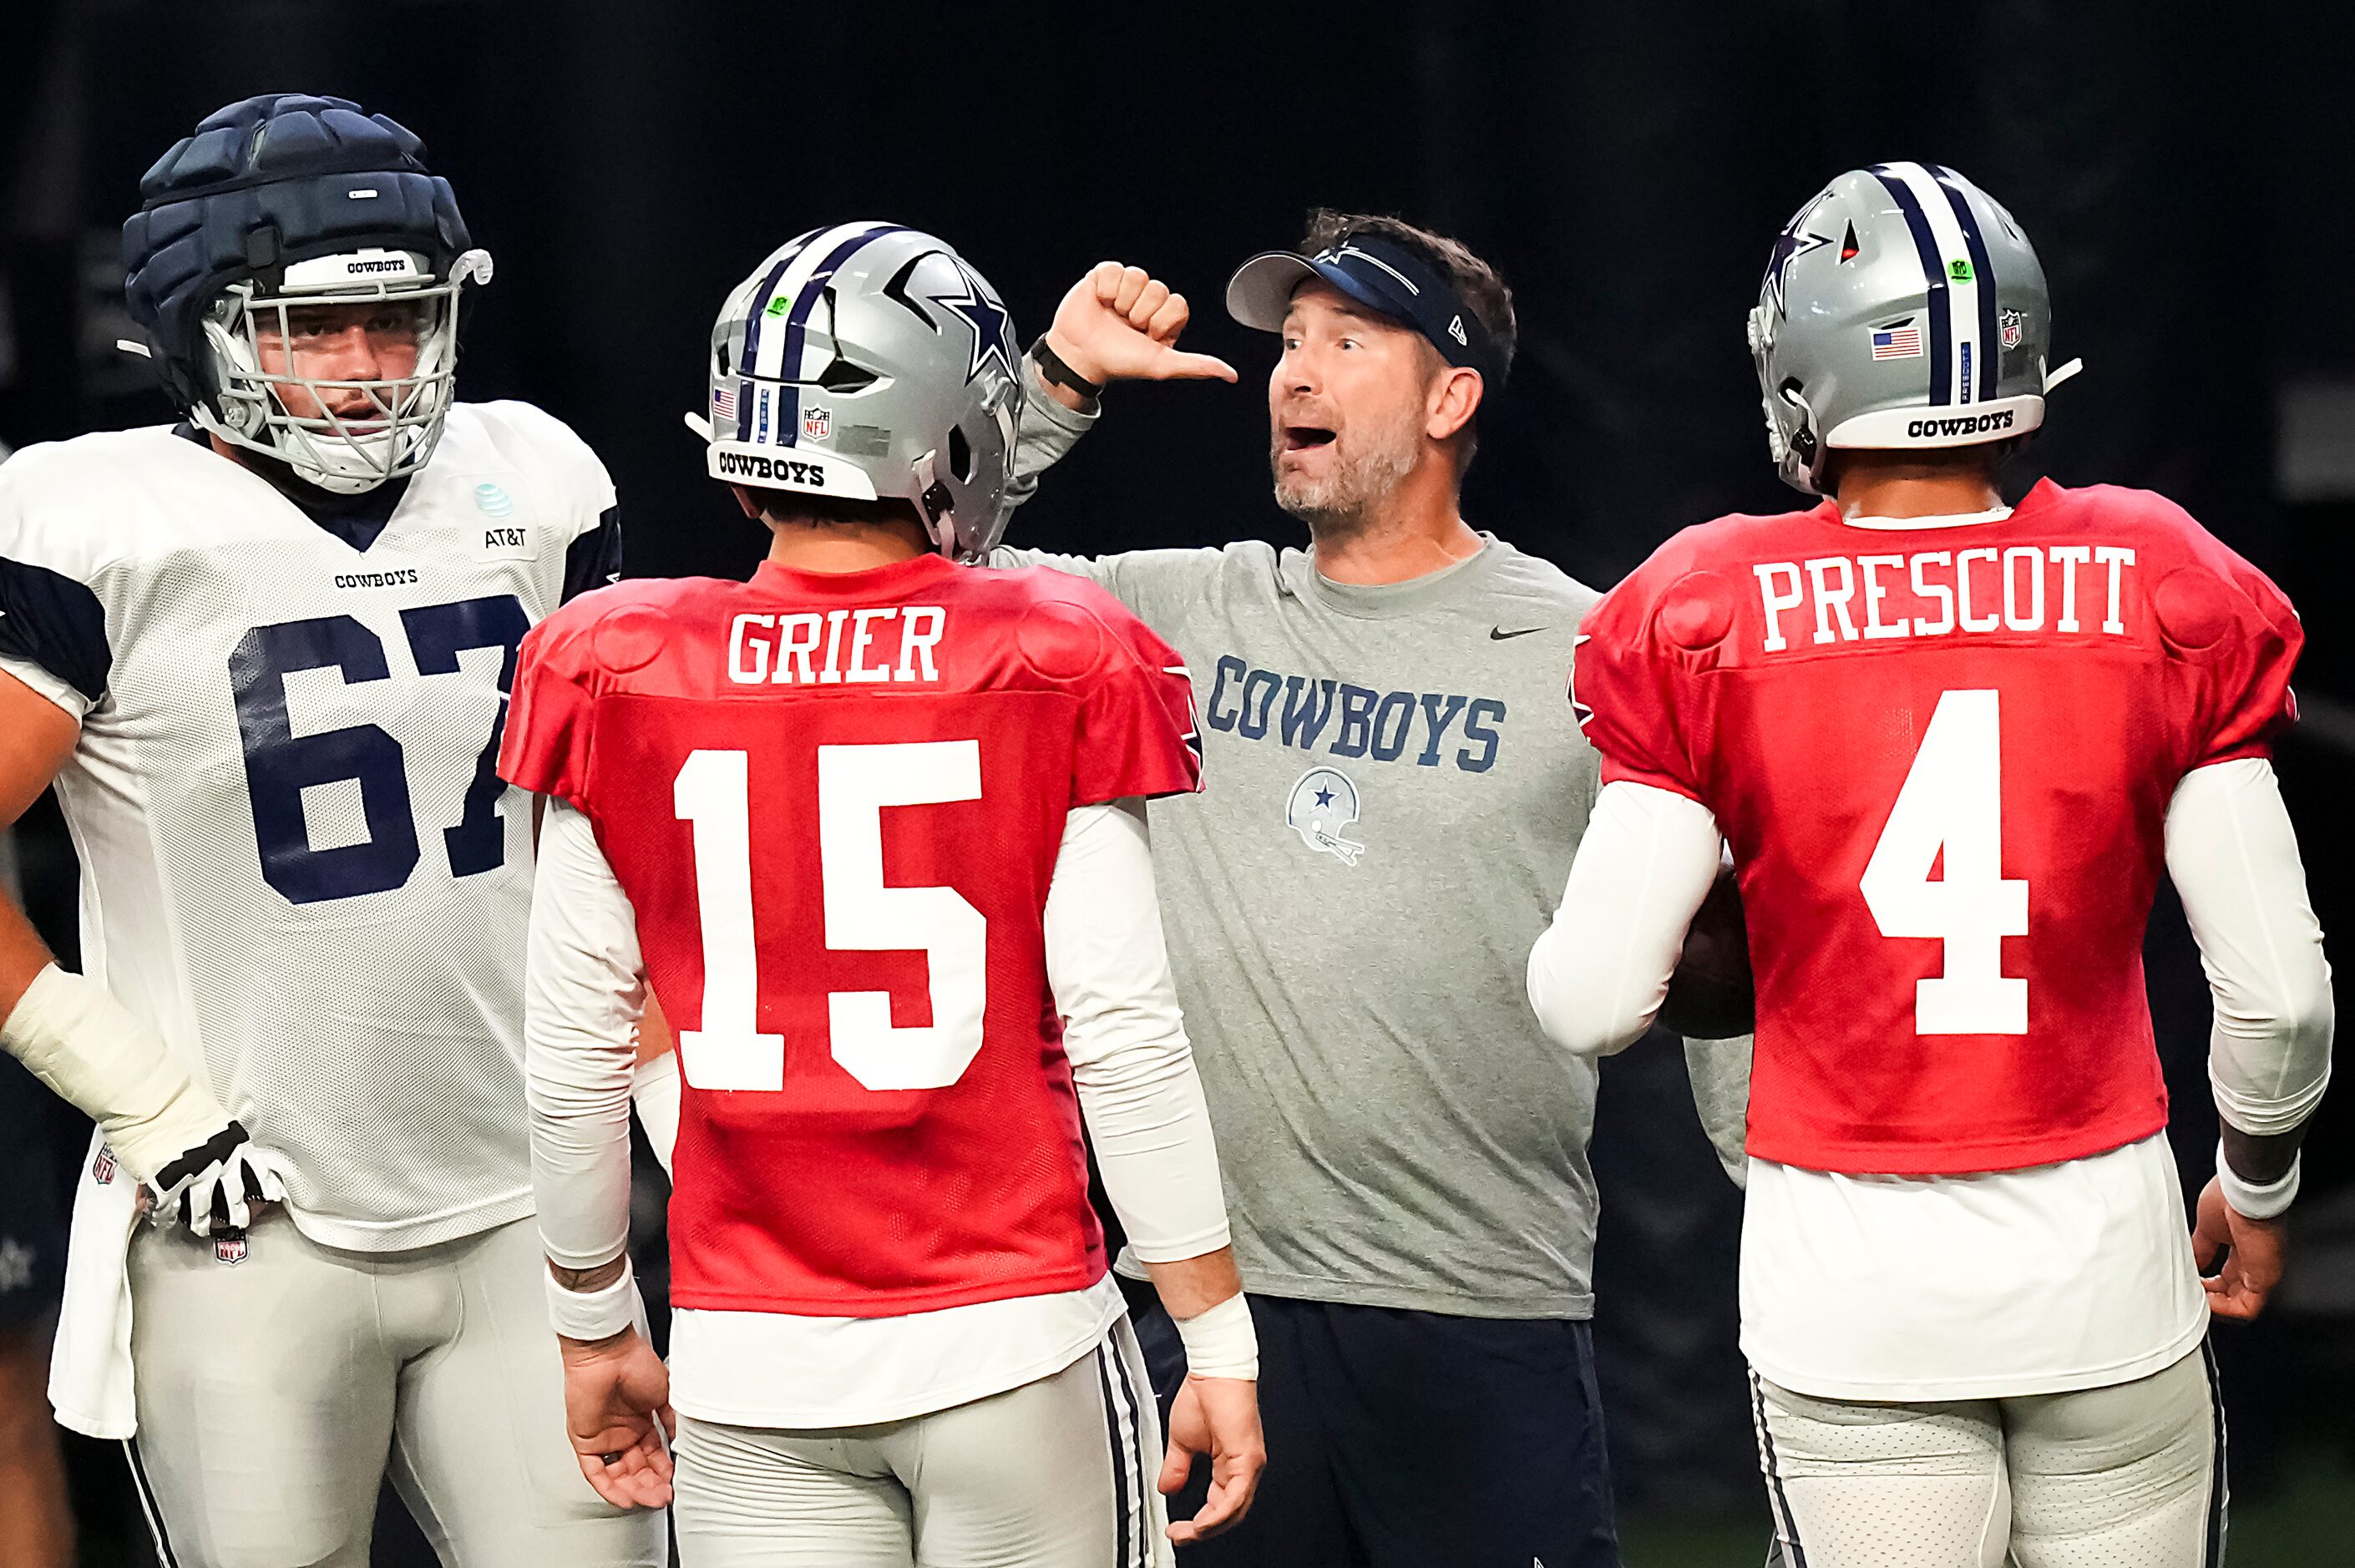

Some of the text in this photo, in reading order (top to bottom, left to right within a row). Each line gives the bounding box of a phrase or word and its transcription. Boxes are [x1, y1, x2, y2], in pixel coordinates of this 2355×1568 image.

[347, 260, 405, 273] COWBOYS
[2004, 326, 2019, 342] NFL
[806, 418, 829, 436] NFL
[1908, 410, 2013, 438] COWBOYS
[719, 452, 824, 487] COWBOYS
[485, 529, 526, 549] AT&T
[335, 569, 418, 588] COWBOYS
[1753, 546, 2135, 652] PRESCOTT
[728, 606, 946, 685] GRIER
[1207, 655, 1507, 773] COWBOYS
[228, 594, 533, 905] 67
[1859, 689, 2029, 1034] 4
[673, 740, 987, 1091] 15
[96, 1155, 115, 1181] NFL
[220, 1240, 245, 1259] NFL
